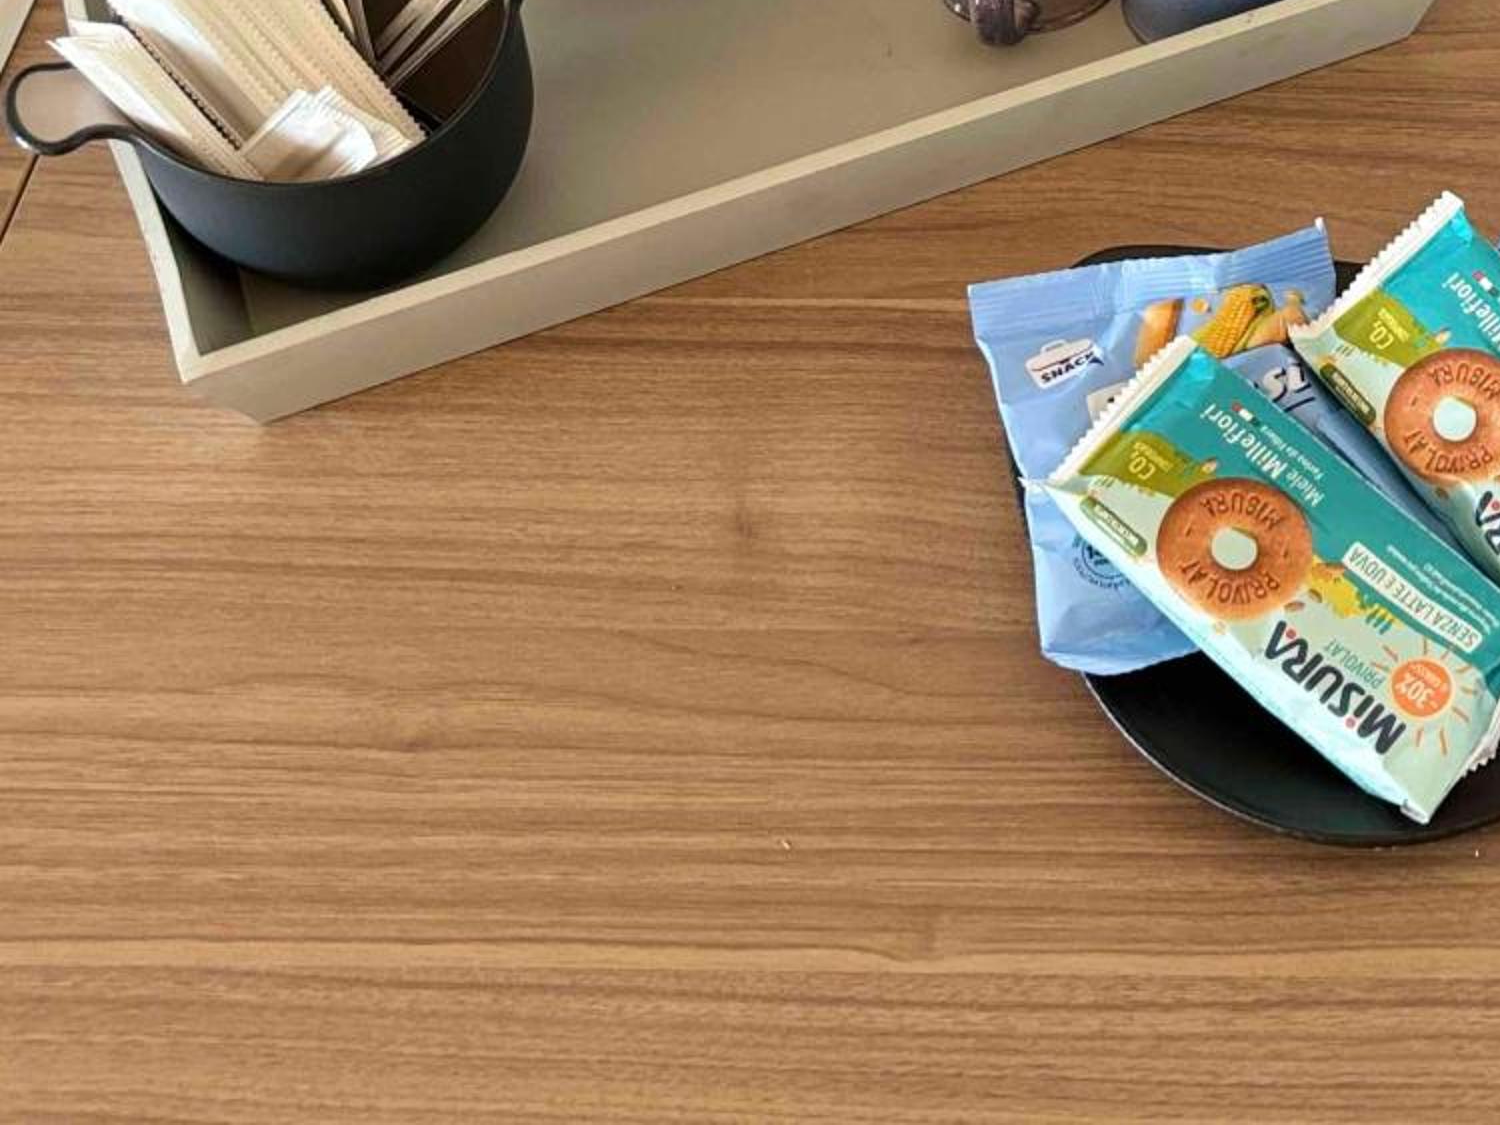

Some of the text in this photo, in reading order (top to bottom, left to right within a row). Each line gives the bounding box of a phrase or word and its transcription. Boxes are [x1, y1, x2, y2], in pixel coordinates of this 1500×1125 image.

[1040, 350, 1100, 383] SNACK
[1197, 400, 1290, 481] Millefiori
[1403, 429, 1494, 474] PRIVOLAT
[1281, 467, 1327, 509] Miele
[1179, 559, 1281, 604] PRIVOLAT
[1347, 546, 1390, 584] UOVA
[1390, 582, 1436, 622] LATTE
[1430, 608, 1480, 652] SENZA
[1322, 639, 1385, 690] PRIVOLAT
